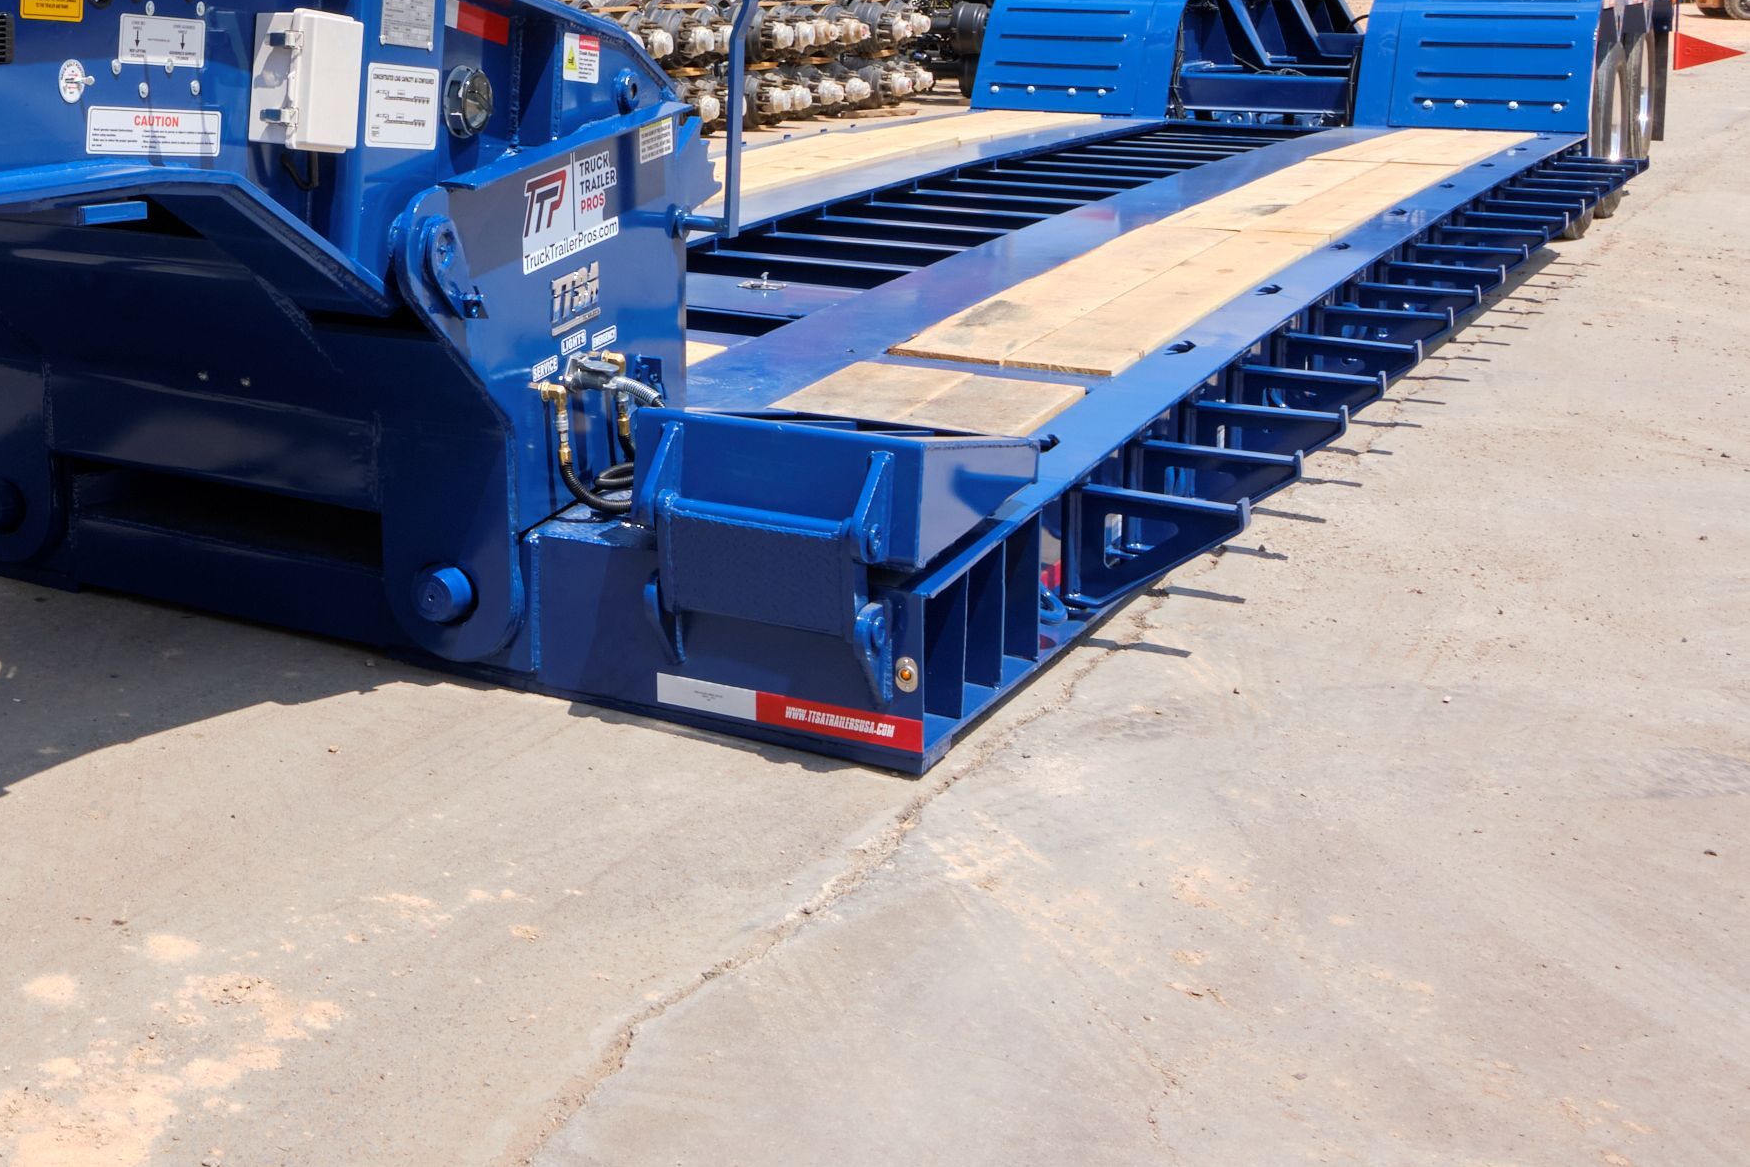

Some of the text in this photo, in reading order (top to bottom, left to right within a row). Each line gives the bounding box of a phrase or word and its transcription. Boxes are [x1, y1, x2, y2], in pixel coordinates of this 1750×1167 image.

[134, 114, 179, 128] CAUTION
[580, 152, 609, 177] TRUCK
[580, 169, 616, 195] TRAILER
[581, 192, 604, 214] PROS
[524, 221, 618, 270] TruckTrailerPros.com
[552, 261, 600, 324] TTSA
[562, 332, 586, 352] LIGHTS
[533, 356, 558, 381] SERVICE
[785, 705, 896, 738] WWW.TTSATRAILERSUSA.COM
